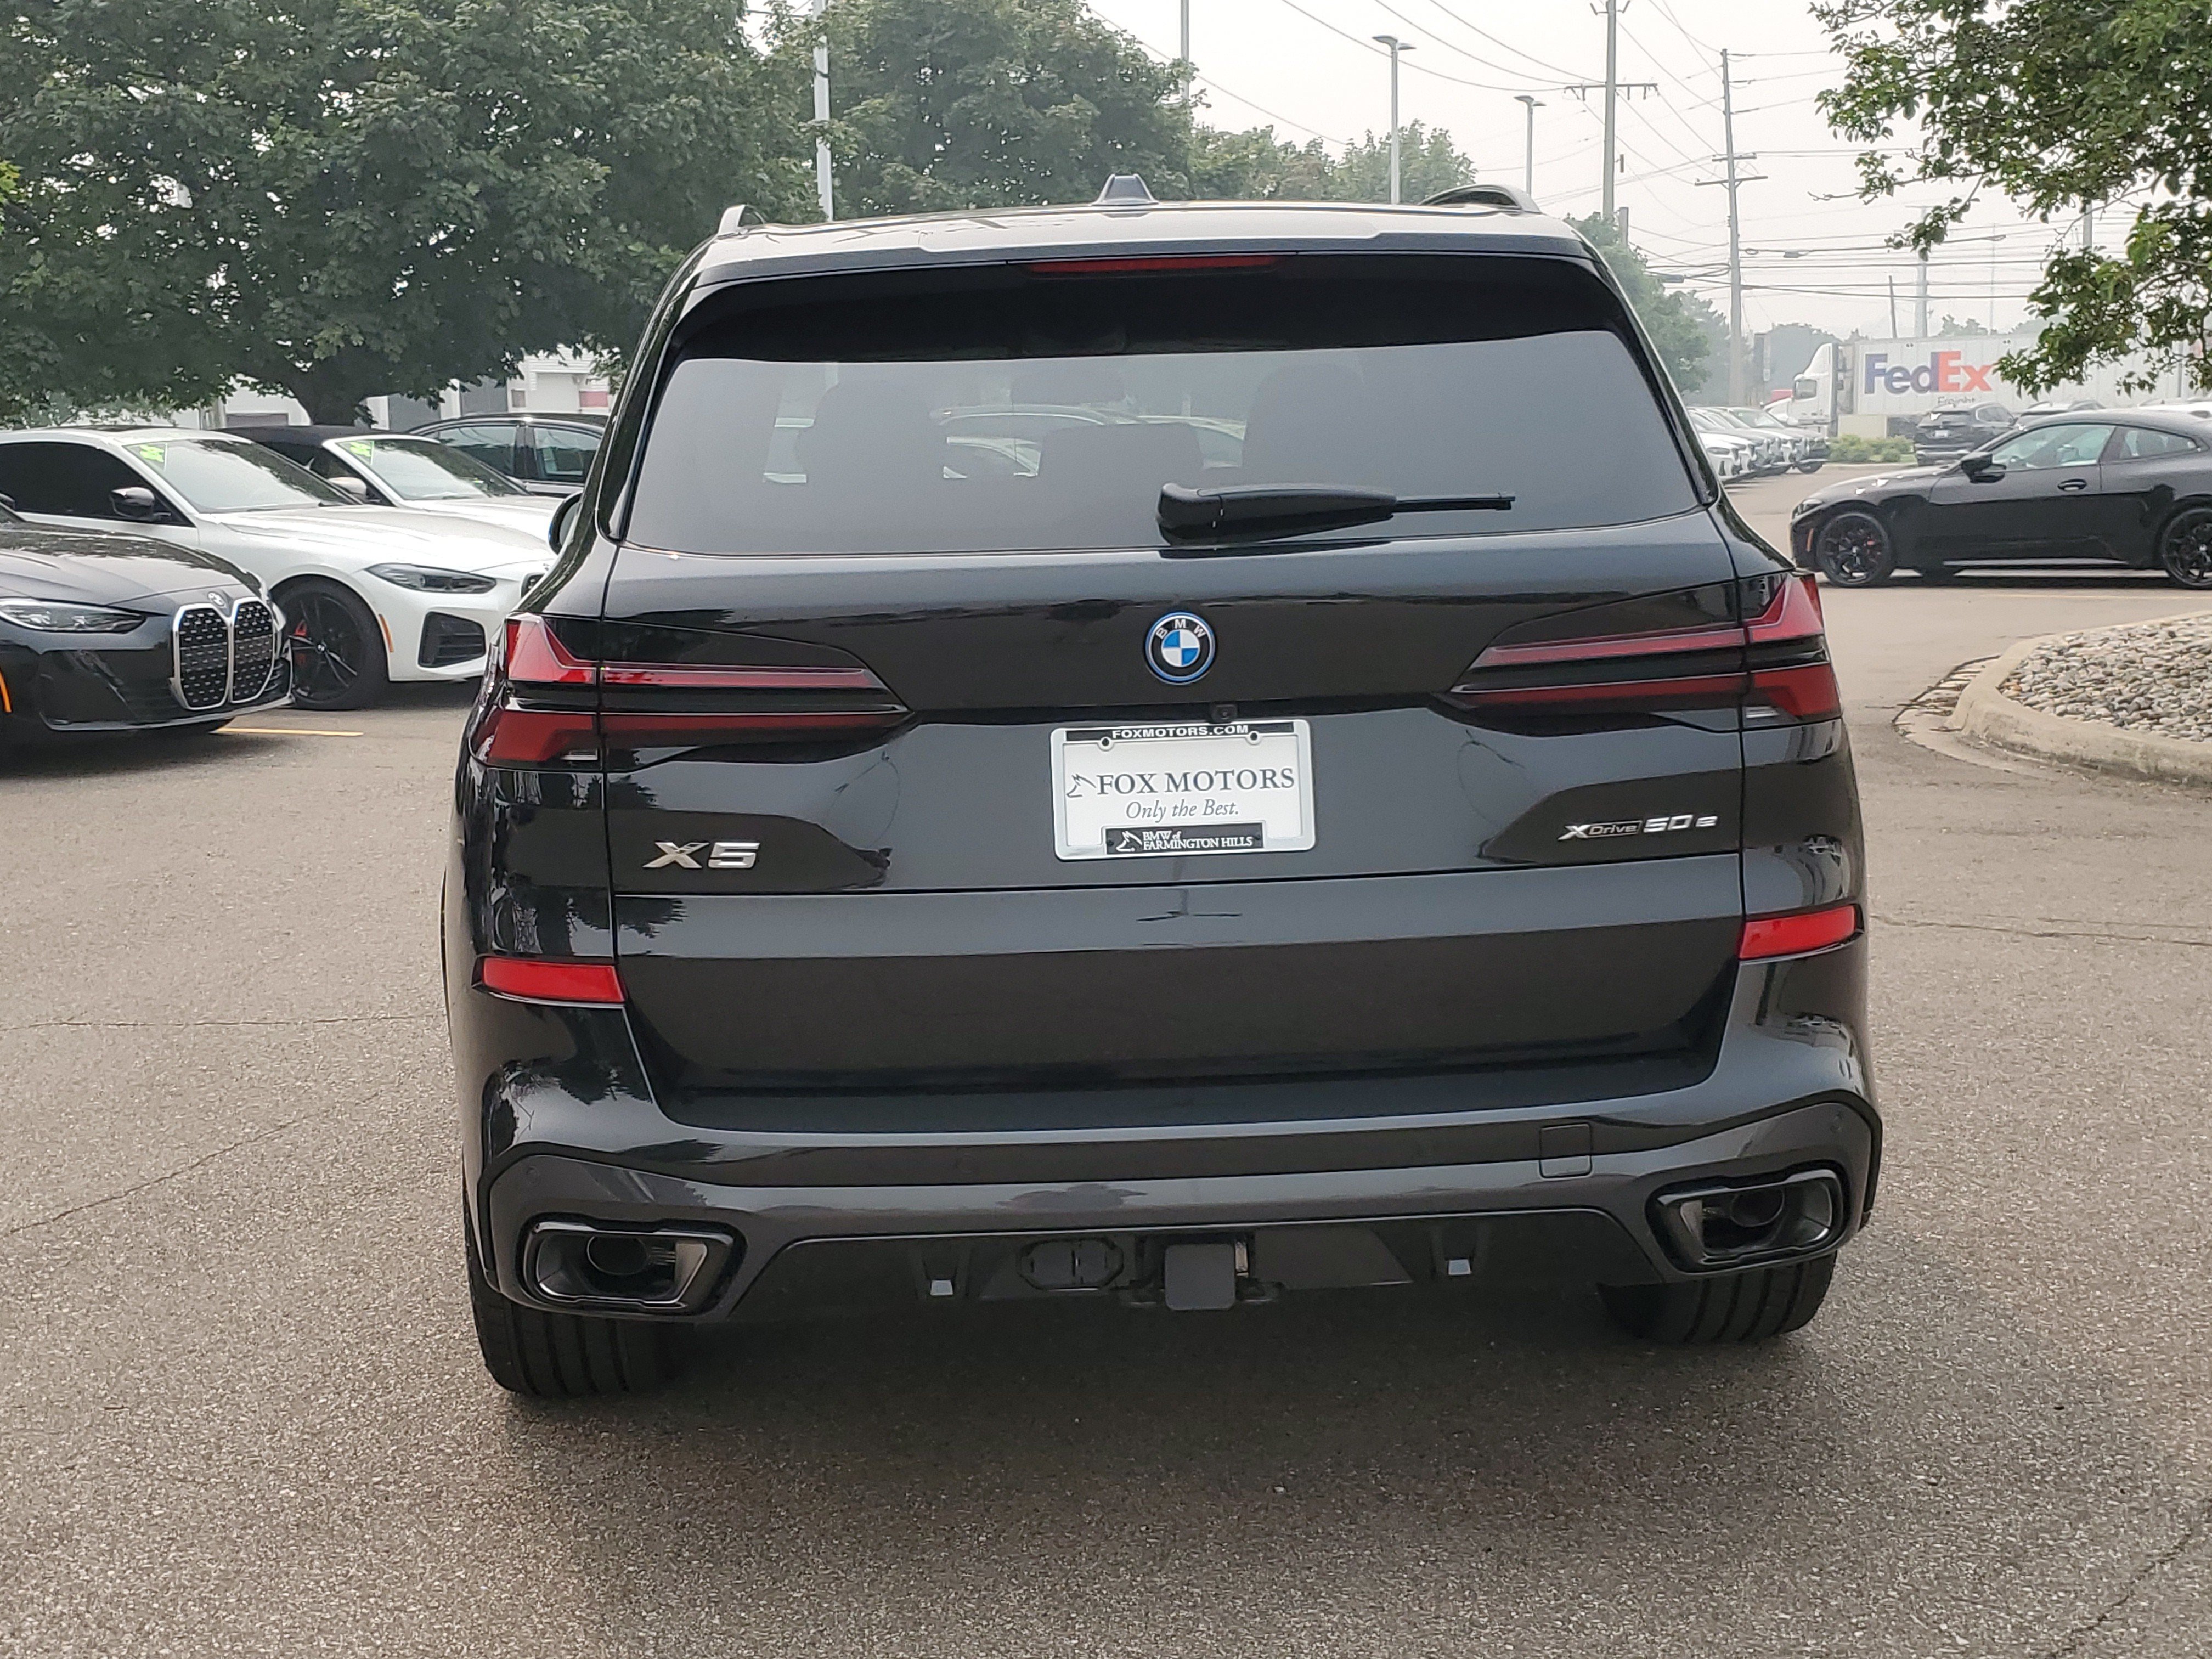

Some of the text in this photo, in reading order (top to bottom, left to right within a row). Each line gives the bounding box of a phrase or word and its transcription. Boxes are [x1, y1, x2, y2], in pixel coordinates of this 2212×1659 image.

[1864, 350, 1995, 394] FedEx
[1155, 619, 1206, 639] BMW
[1112, 725, 1249, 740] FOXMOTORS.COM
[1097, 768, 1295, 795] FOX MOTORS
[1126, 799, 1239, 823] Only the Best.
[1143, 830, 1182, 841] BMW of
[1143, 836, 1253, 850] FARMINGTON HILLS
[642, 842, 761, 868] X5
